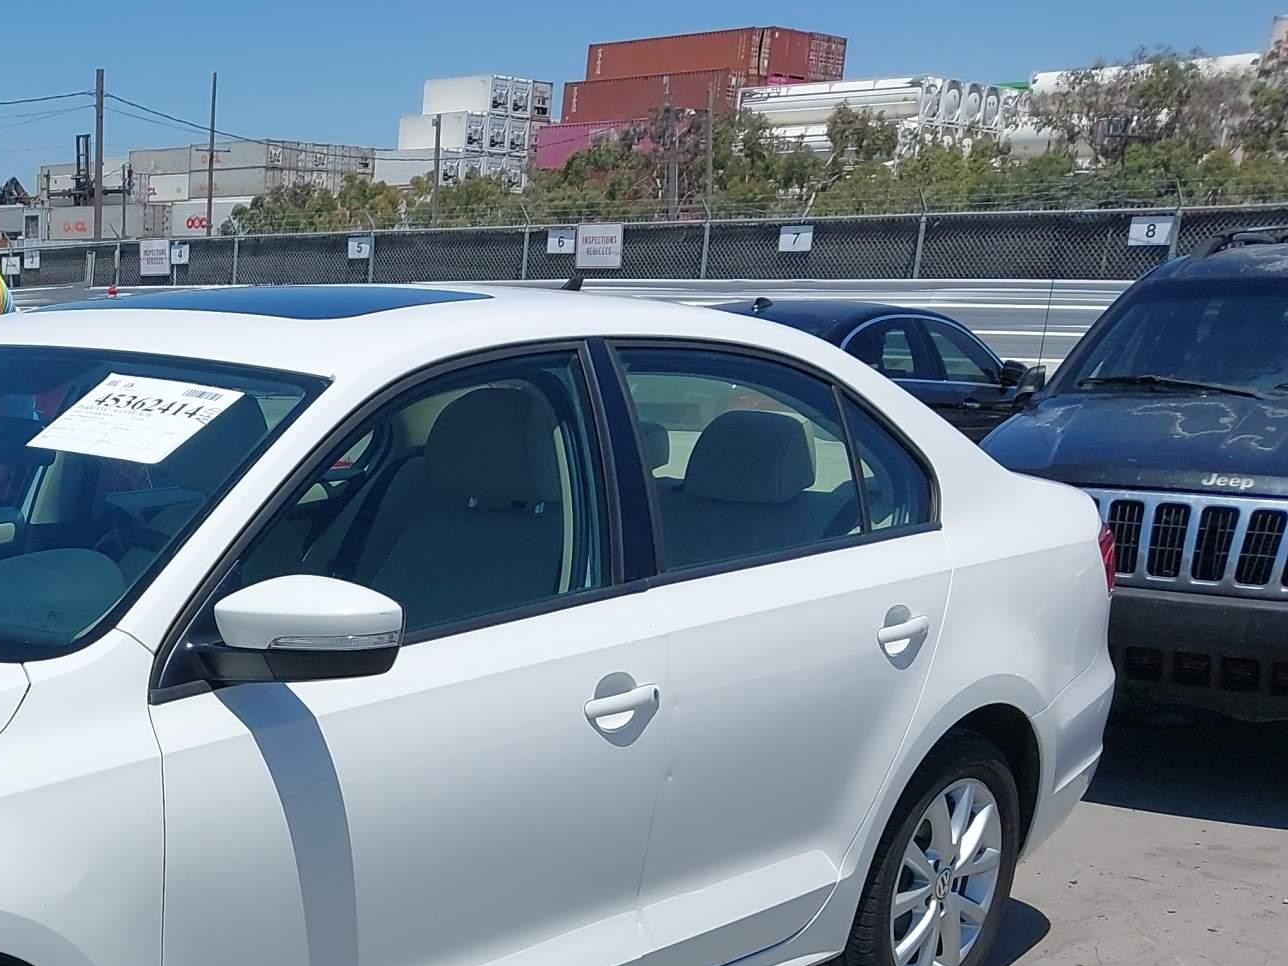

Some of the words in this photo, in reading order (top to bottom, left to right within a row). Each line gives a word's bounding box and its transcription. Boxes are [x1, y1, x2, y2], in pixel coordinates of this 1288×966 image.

[1146, 224, 1156, 238] 8
[558, 236, 565, 248] 6
[792, 232, 800, 245] 7
[177, 249, 183, 259] 4
[356, 243, 363, 253] 5
[94, 393, 205, 418] 45362414
[1201, 473, 1255, 490] Jeep
